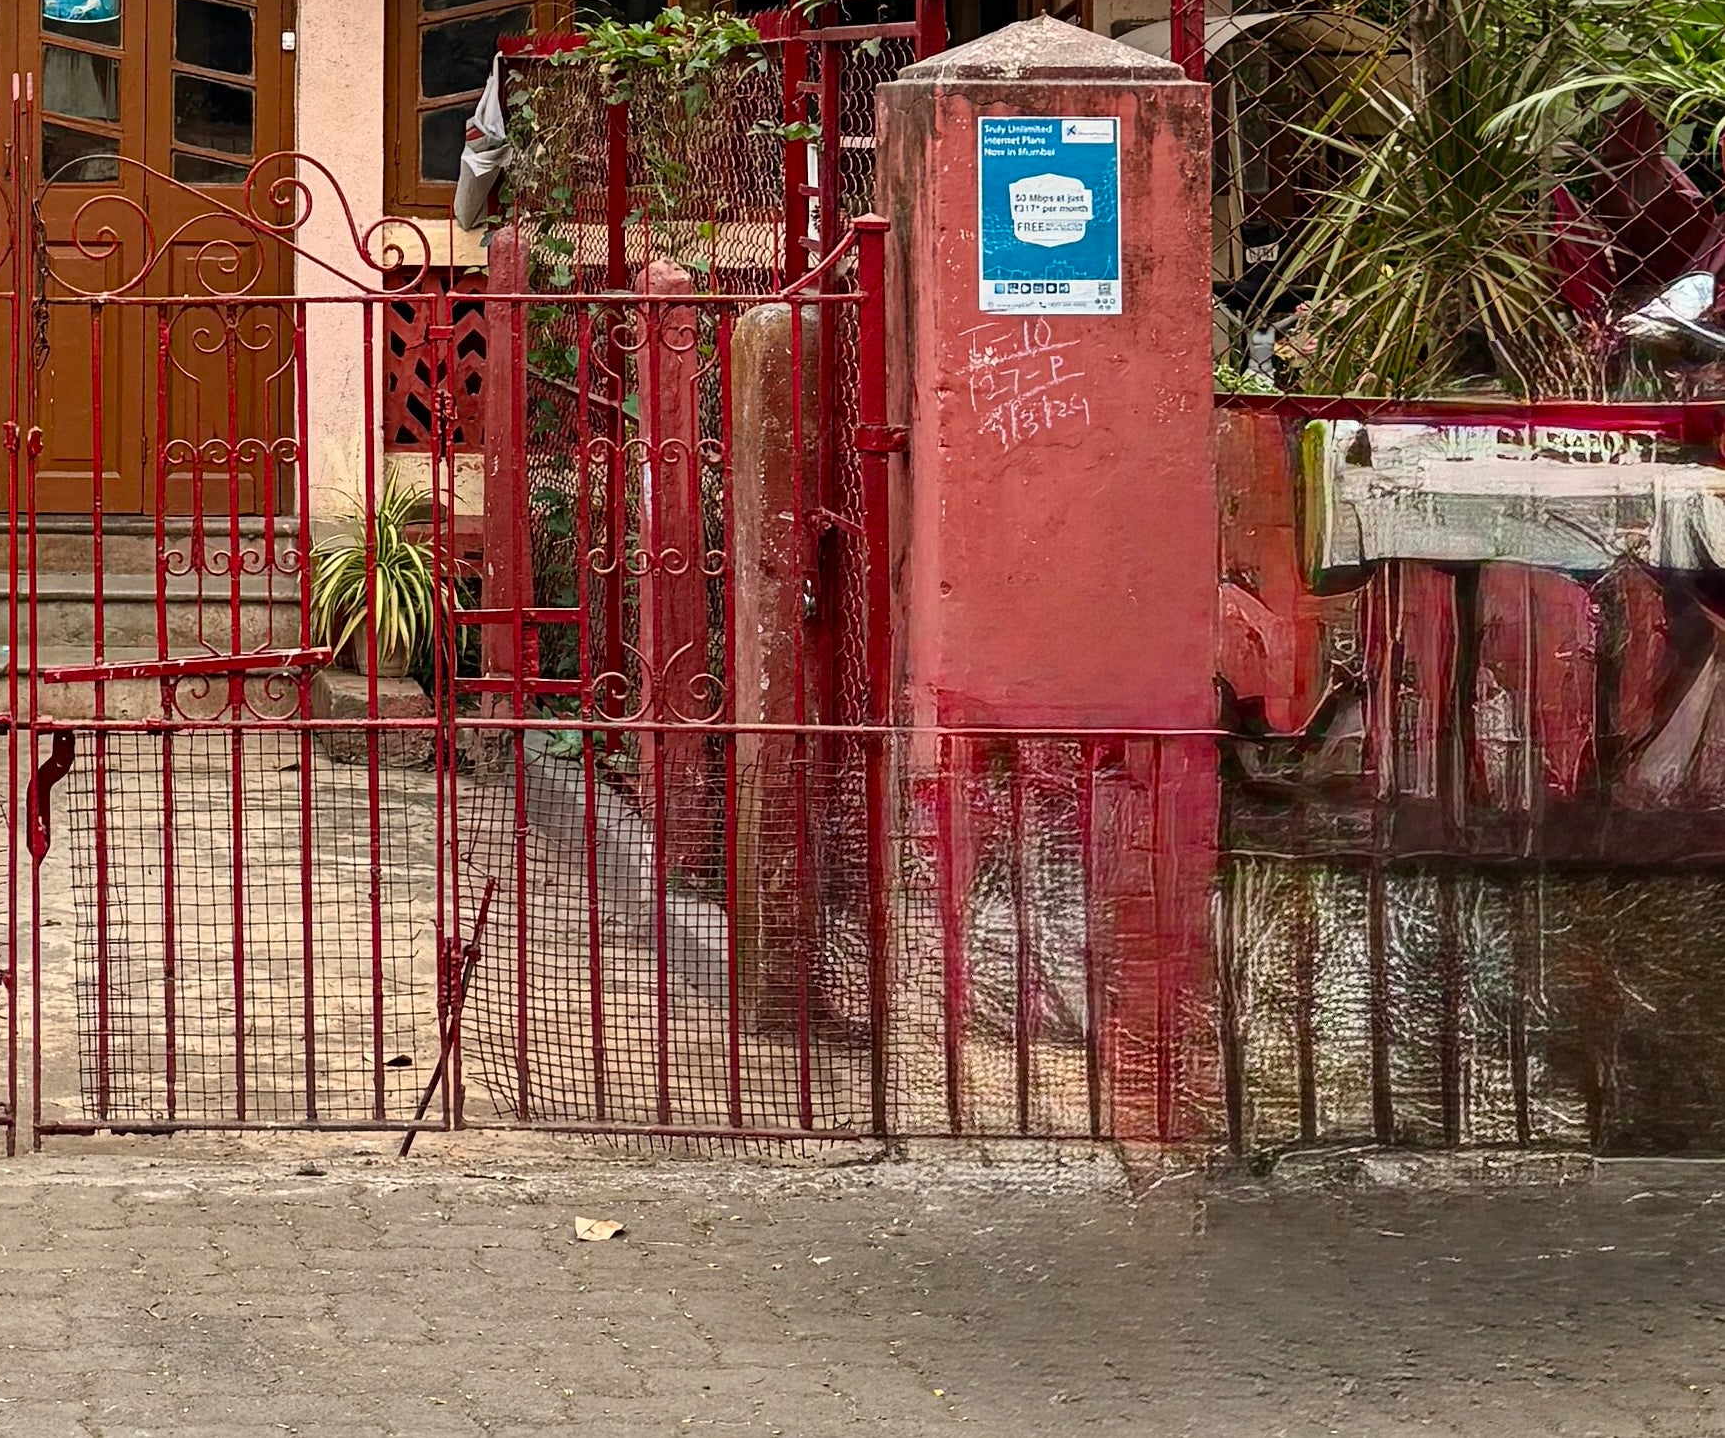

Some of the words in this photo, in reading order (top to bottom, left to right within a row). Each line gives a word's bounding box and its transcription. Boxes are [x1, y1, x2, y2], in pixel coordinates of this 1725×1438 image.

[984, 124, 1006, 134] Truly
[1008, 124, 1053, 134] Unlimited
[1022, 135, 1046, 145] Plans
[984, 147, 1005, 156] Now
[1007, 146, 1016, 156] in
[1018, 146, 1056, 156] Mumbai
[1067, 194, 1084, 203] just
[1017, 222, 1045, 231] FREE
